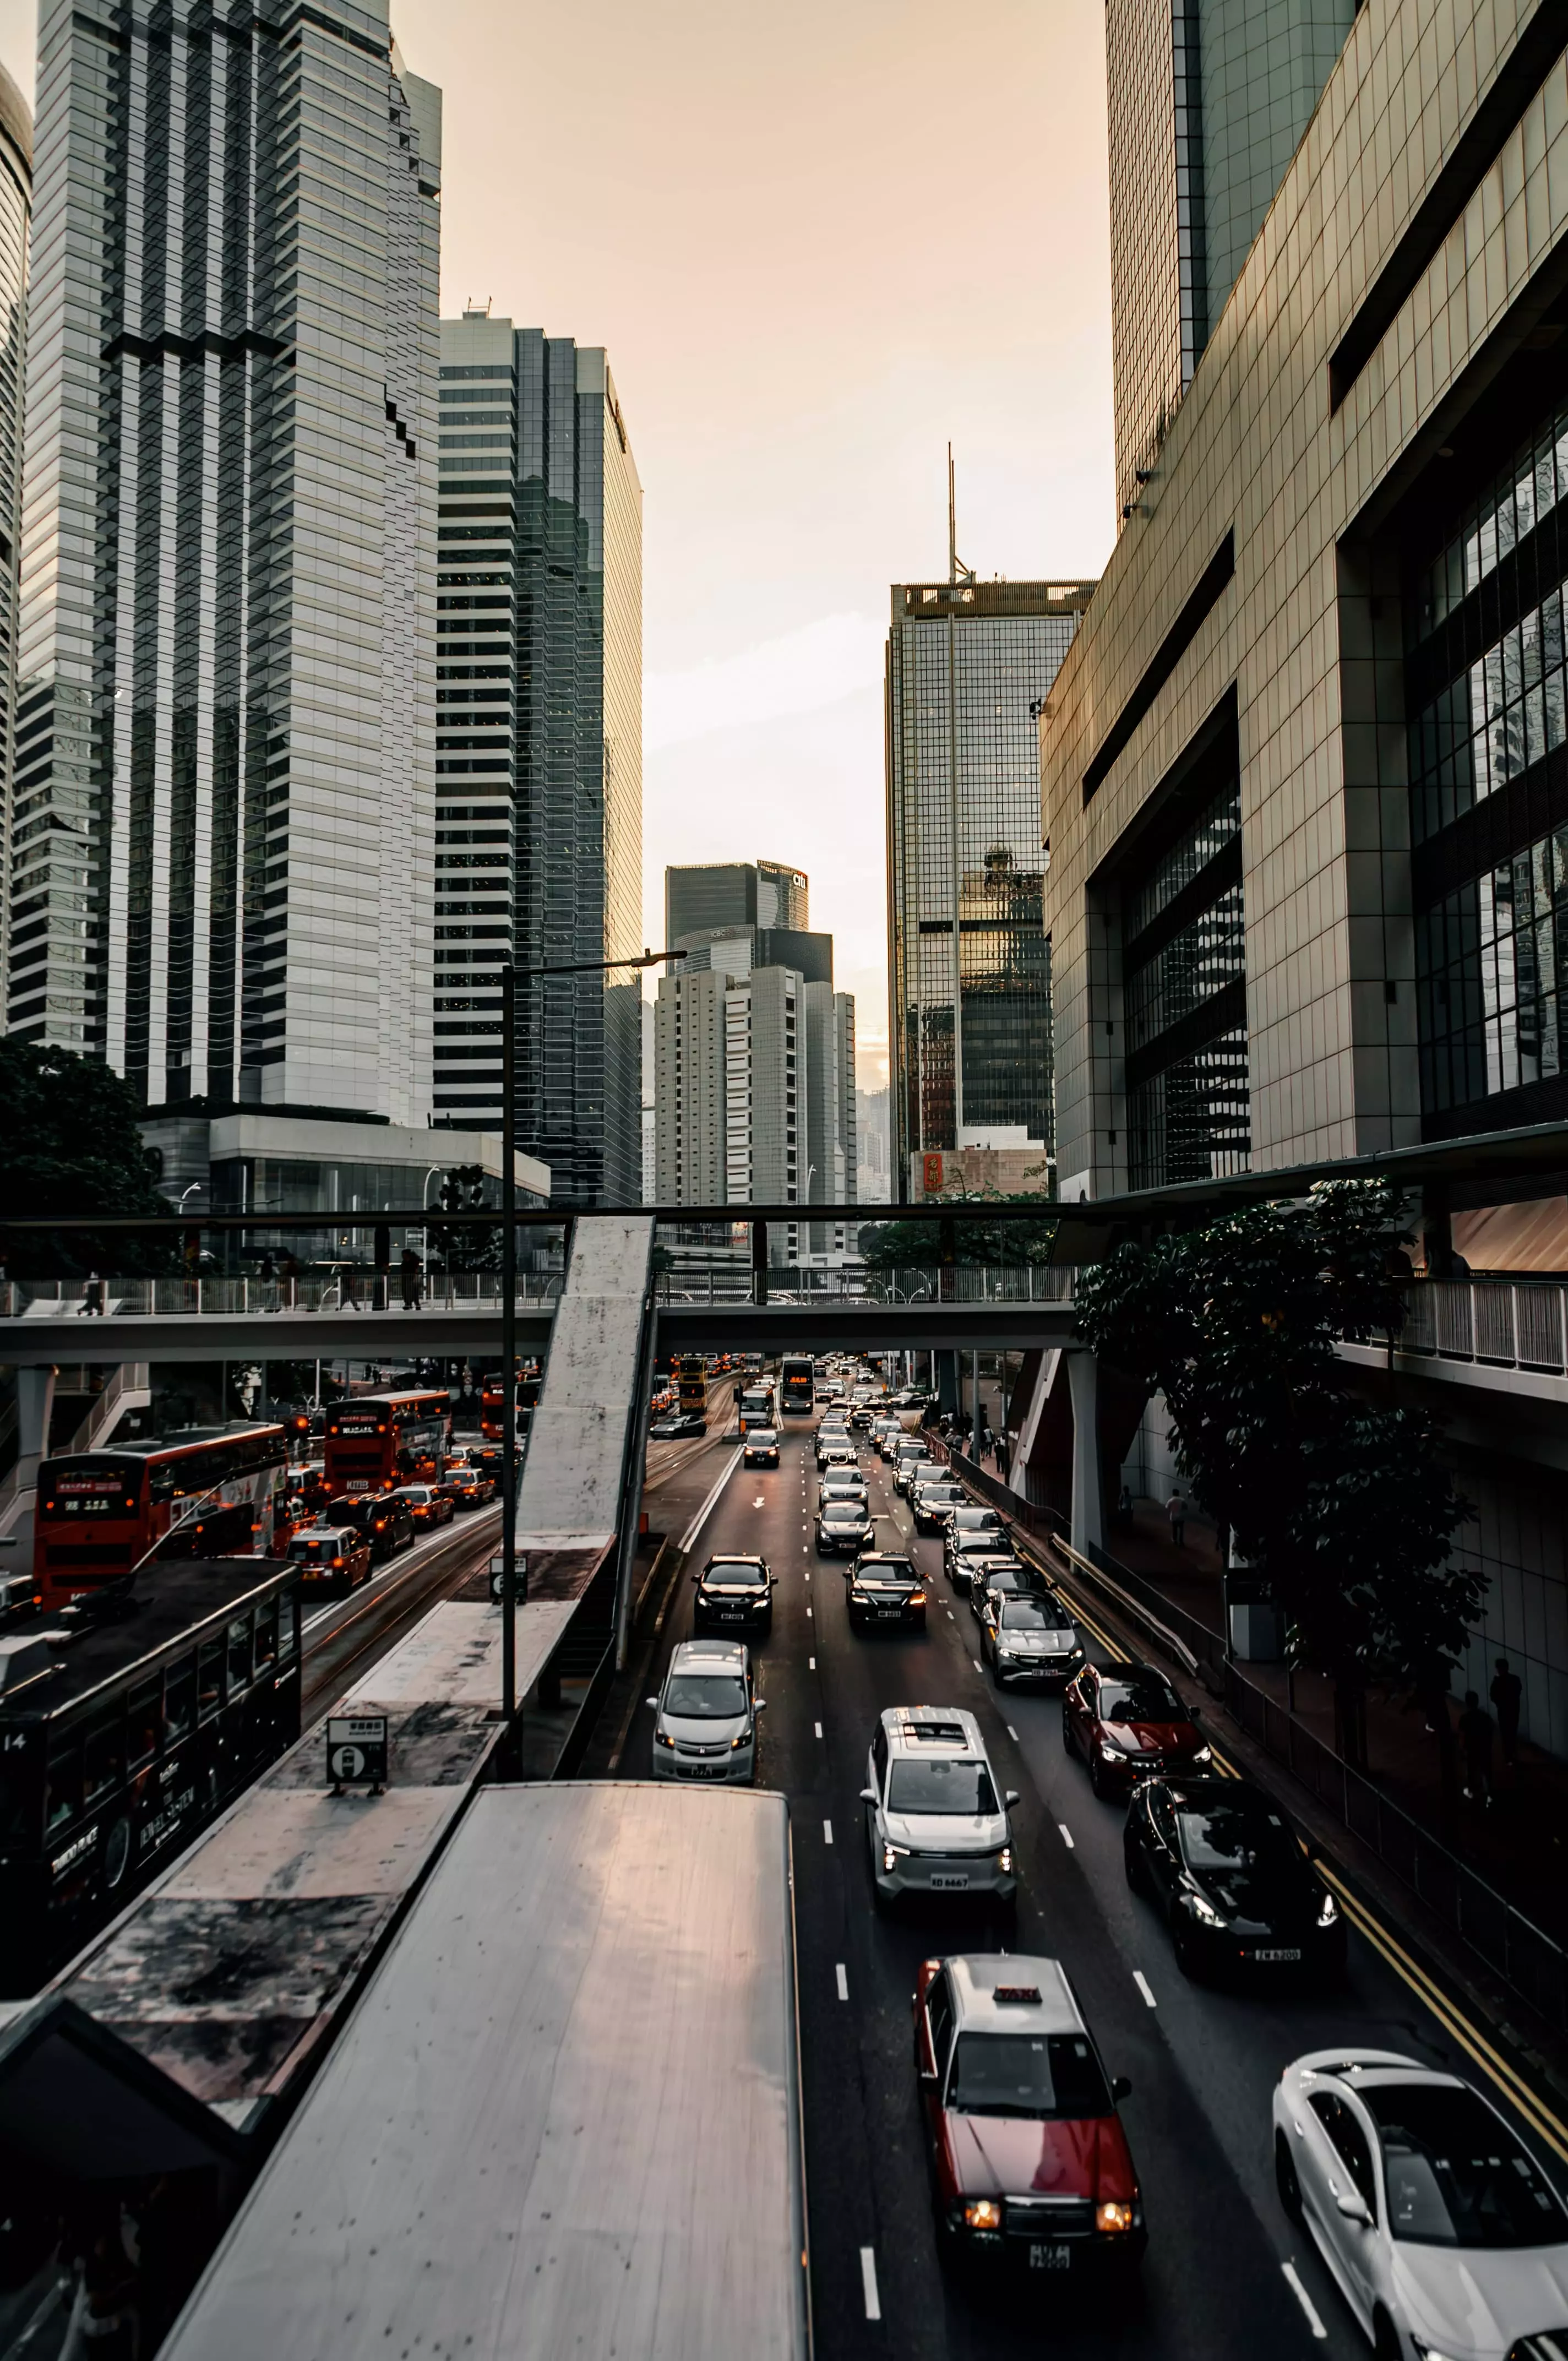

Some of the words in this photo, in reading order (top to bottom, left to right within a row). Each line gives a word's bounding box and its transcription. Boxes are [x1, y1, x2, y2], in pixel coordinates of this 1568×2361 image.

[793, 873, 805, 889] citi
[710, 929, 725, 938] ICBC
[3, 1732, 28, 1753] 14
[998, 1988, 1037, 1999] TAXI
